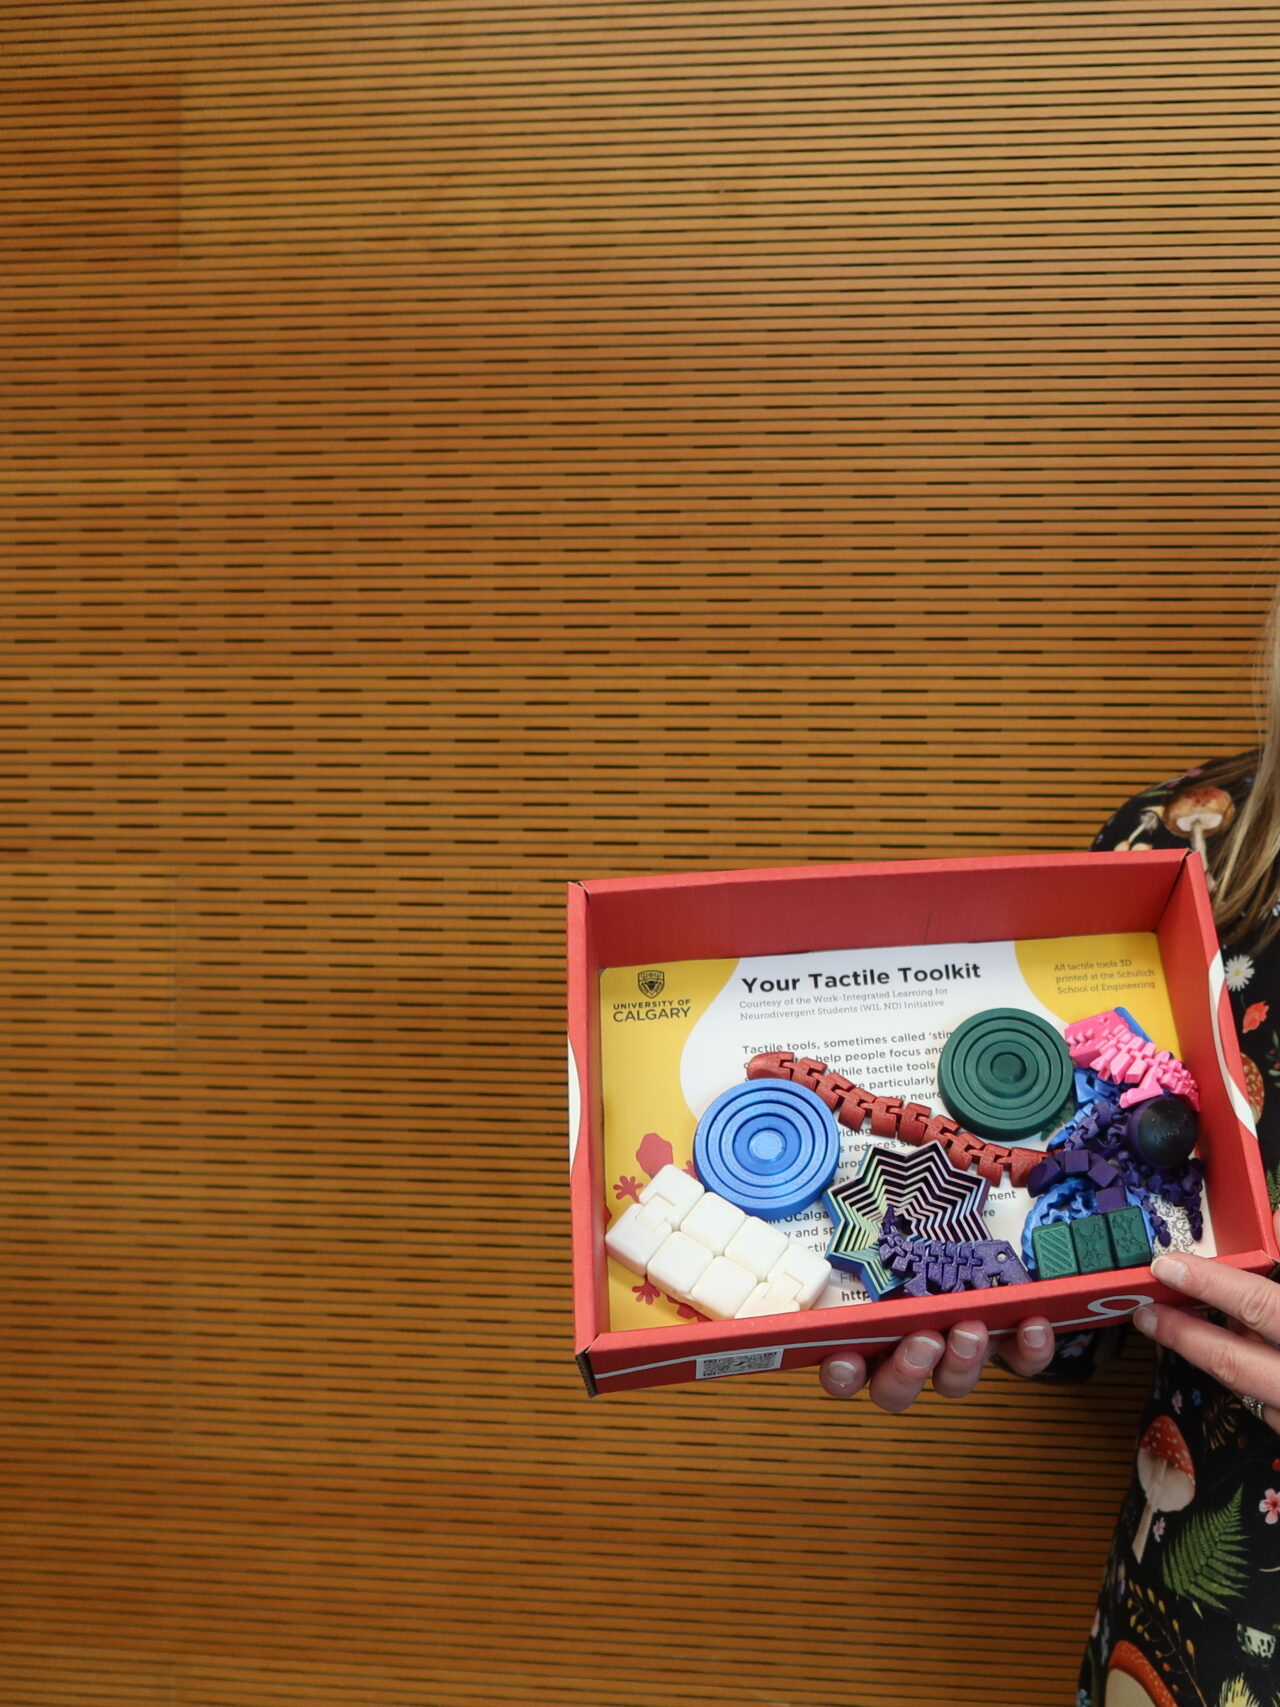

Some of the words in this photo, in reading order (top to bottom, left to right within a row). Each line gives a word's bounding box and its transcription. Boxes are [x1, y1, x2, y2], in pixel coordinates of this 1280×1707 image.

[1054, 963, 1066, 971] All
[1067, 961, 1094, 970] tactile
[1096, 960, 1118, 968] tools
[1120, 959, 1132, 967] 3D
[741, 977, 800, 993] Your
[808, 969, 890, 989] Tactile
[897, 963, 981, 983] Toolkit
[1056, 973, 1088, 984] printed
[1116, 969, 1155, 978] Schulich
[1057, 985, 1088, 994] School
[1101, 981, 1155, 991] Engineering
[613, 1000, 674, 1010] UNIVERSITY
[739, 999, 782, 1009] Courtesy
[784, 998, 794, 1006] of
[813, 991, 890, 1003] Work-Integrated
[892, 988, 932, 998] Learning
[935, 987, 947, 995] for
[613, 1007, 691, 1022] CALGARY
[740, 1008, 815, 1020] Neurodivergent
[817, 1005, 857, 1015] Students
[884, 1001, 902, 1011] ND)
[904, 999, 944, 1009] Initiative
[742, 1043, 783, 1053] Tactile
[787, 1041, 820, 1051] tools,
[823, 1036, 887, 1048] sometimes
[891, 1032, 926, 1042] called
[815, 1054, 841, 1063] help
[845, 1051, 886, 1063] people
[889, 1049, 920, 1057] focus
[866, 1063, 903, 1075] tactile
[906, 1061, 935, 1071] tools
[869, 1076, 936, 1089] particularly
[795, 1226, 818, 1237] and
